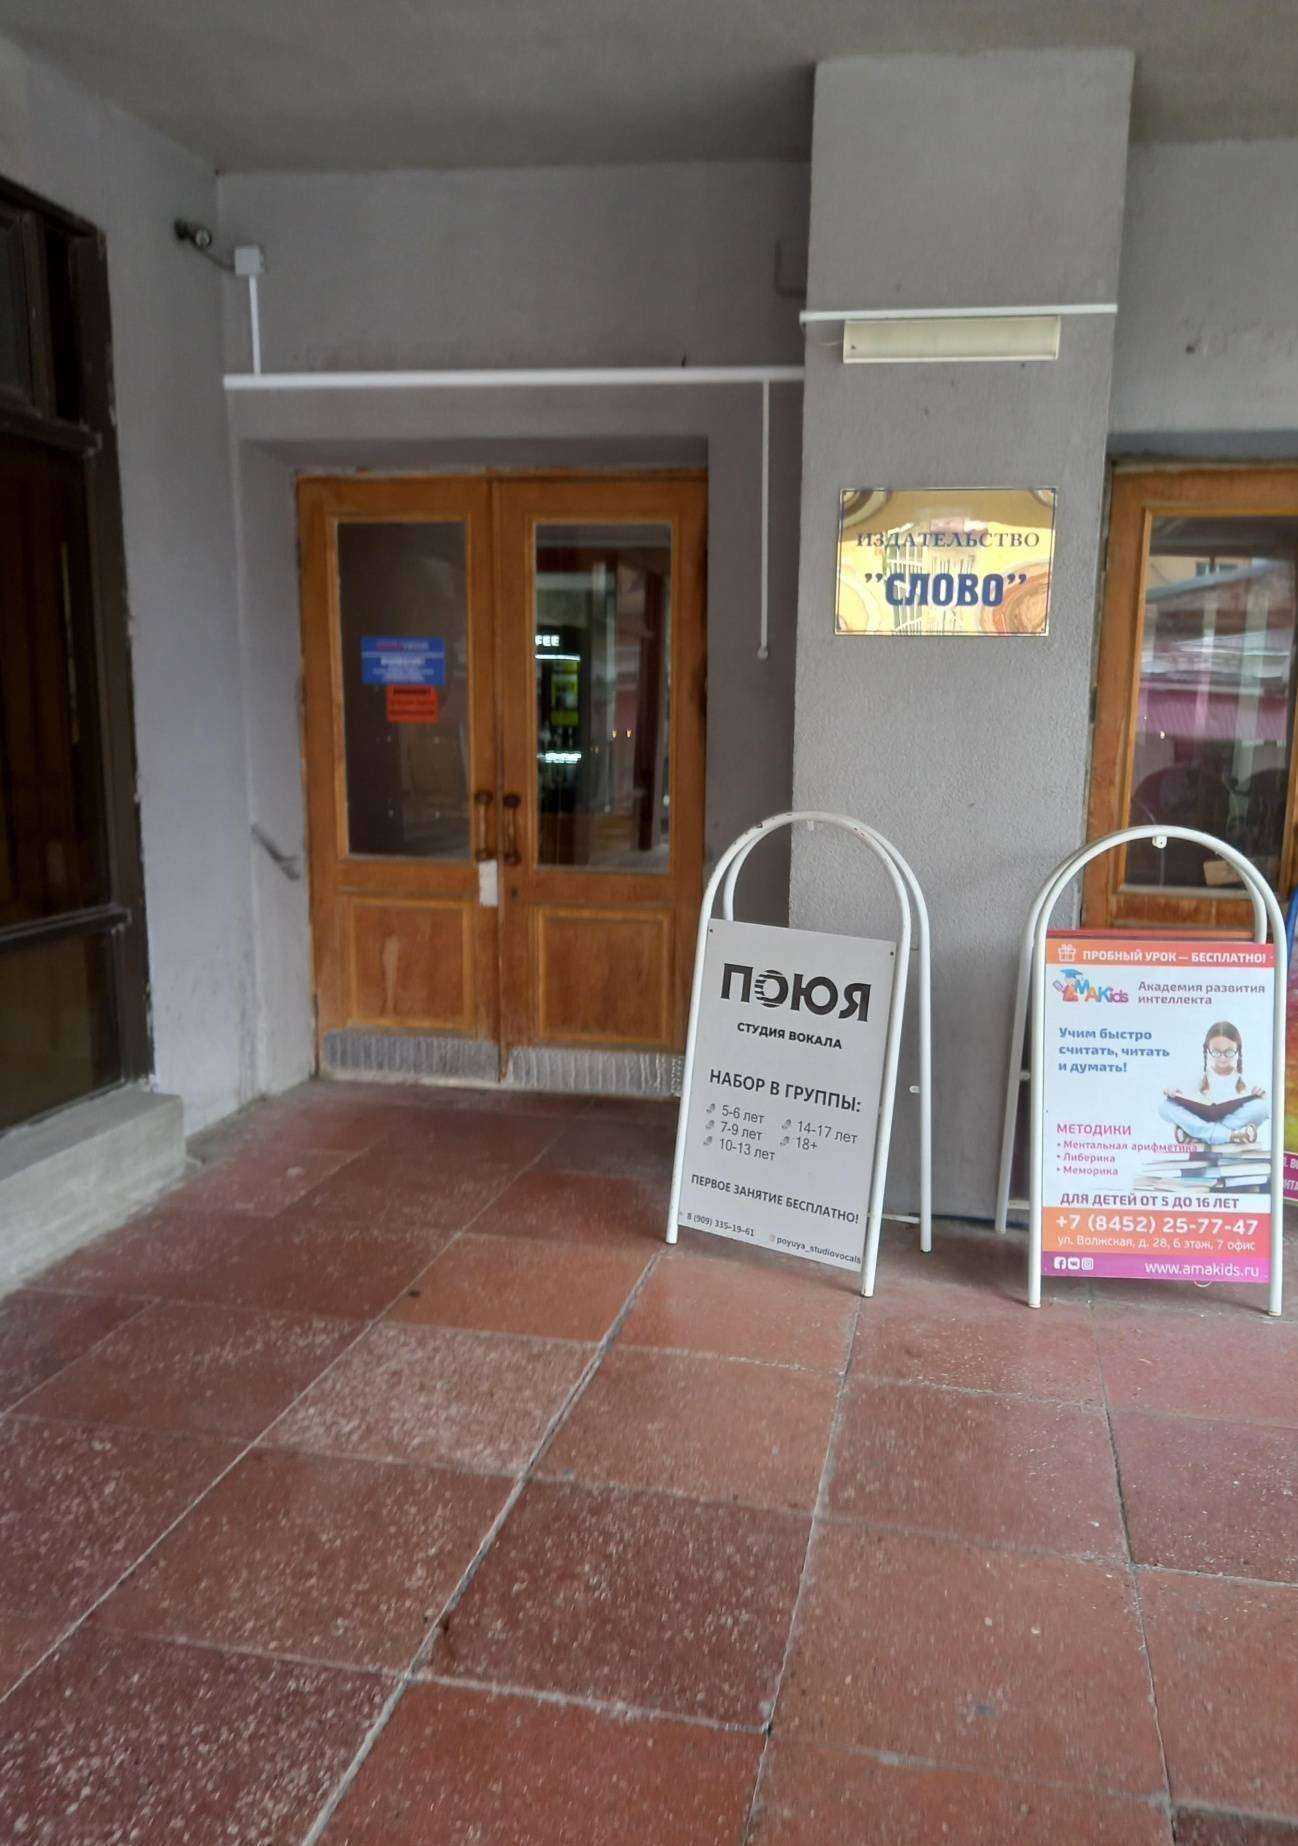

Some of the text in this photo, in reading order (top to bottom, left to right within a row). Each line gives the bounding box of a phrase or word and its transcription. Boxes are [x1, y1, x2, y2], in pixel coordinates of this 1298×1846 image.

[856, 532, 1040, 548] ИЗДАТЕЛЬСТВО
[1082, 949, 1142, 962] ПРОБНЫЙ
[1145, 951, 1177, 963] УРОК
[1191, 951, 1267, 964] БЕСПЛАТНО!
[720, 963, 872, 1022] ПОЮЯ
[1138, 981, 1266, 995] Академия развития
[1137, 995, 1213, 1005] интеллекта
[737, 1022, 843, 1049] СТУДИЯ ВОКАЛА
[1058, 1027, 1153, 1042] Учим быстро
[1058, 1045, 1170, 1058] считать, читать
[1058, 1062, 1128, 1074] и думать!
[710, 1069, 862, 1112] НАБОР В ГРУППЫ:
[721, 1104, 765, 1124] 5-6 лет
[720, 1121, 763, 1141] 7-9 лет
[797, 1120, 858, 1145] 14-17 лет
[1056, 1123, 1132, 1136] МЕТОДИКИ
[719, 1138, 776, 1161] 10-13 лет
[796, 1136, 818, 1151] 18+
[1063, 1140, 1198, 1153] Ментальная арифметика
[690, 1174, 860, 1224] ПЕРВОЕ ЗАНЯТИЕ БЕСПЛАТНО!
[1060, 1192, 1240, 1209] ДЛЯ ДЕТЕЙ ОТ 5 ДО 16 ЛЕТ
[693, 1213, 713, 1227] (909)
[1056, 1214, 1259, 1235] +7 (8452) 25-77-47
[1057, 1235, 1256, 1252] ул. Волжская, д. 28, 6 этаж, 7 офис
[1144, 1261, 1260, 1277] www.amakids.ru
